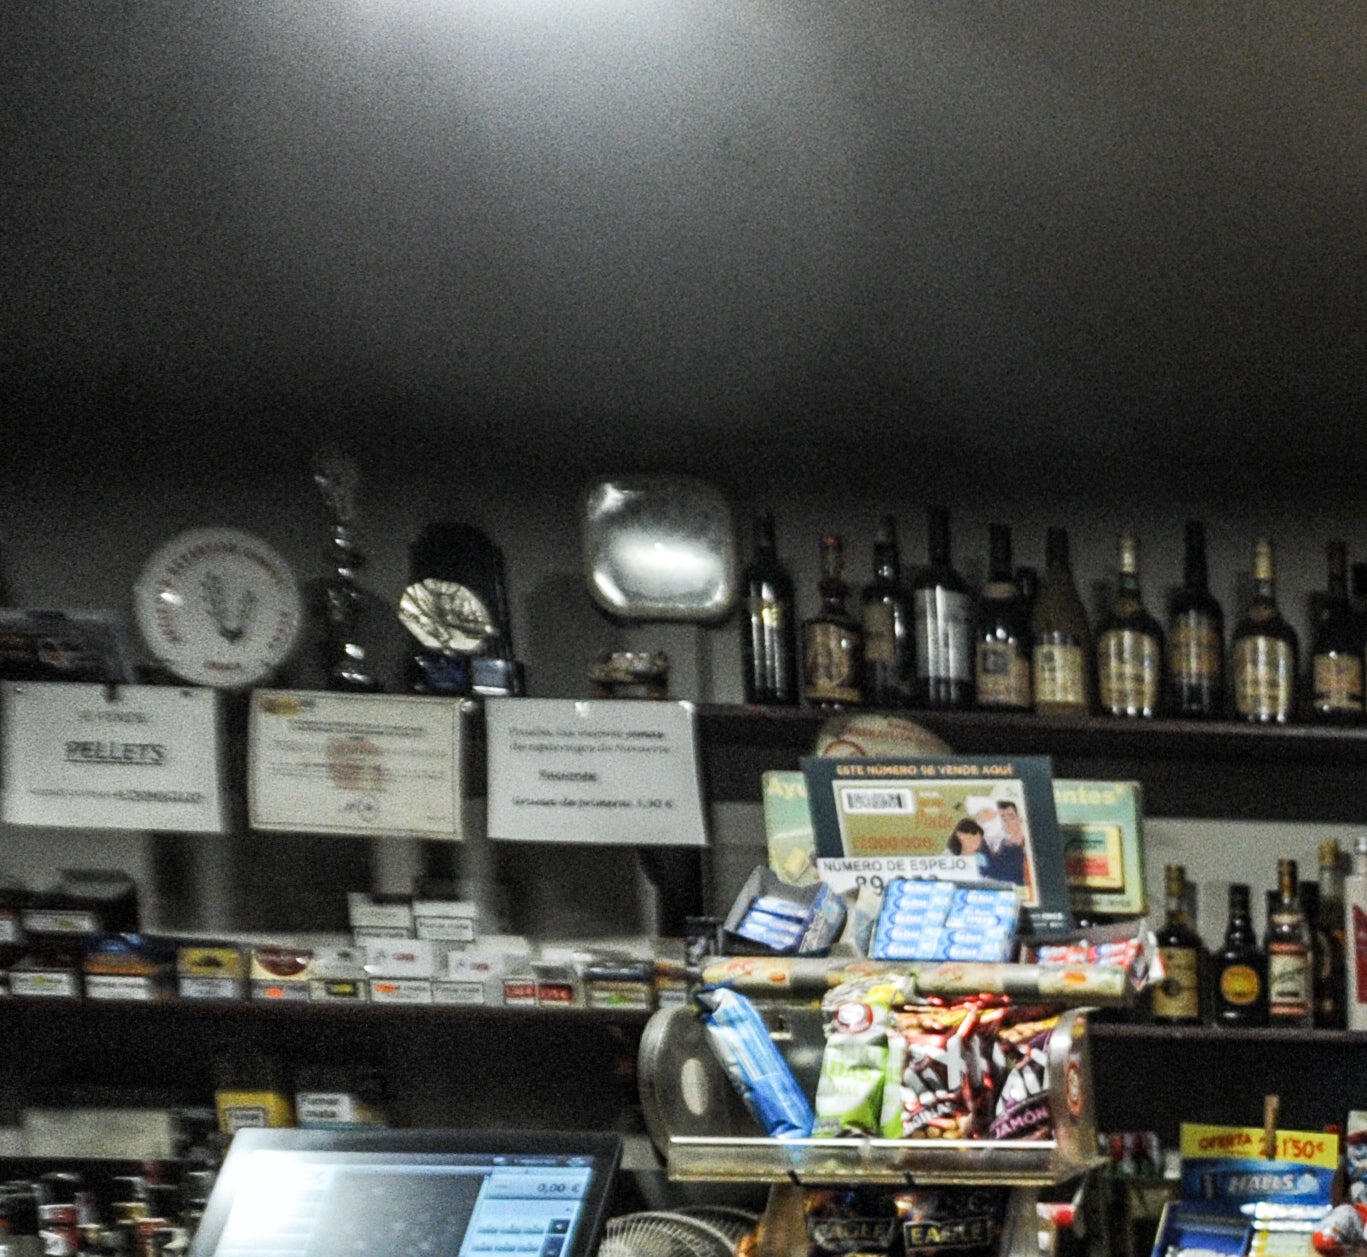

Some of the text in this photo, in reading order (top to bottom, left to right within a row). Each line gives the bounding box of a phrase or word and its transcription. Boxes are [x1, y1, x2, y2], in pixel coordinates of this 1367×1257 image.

[65, 741, 166, 762] PELLETS
[836, 765, 864, 776] ESTE
[937, 766, 980, 776] VENDE
[823, 858, 967, 872] NÚMERO DE ESPEJO
[995, 1107, 1049, 1139] JAMÓN
[1199, 1132, 1253, 1150] OFERTA
